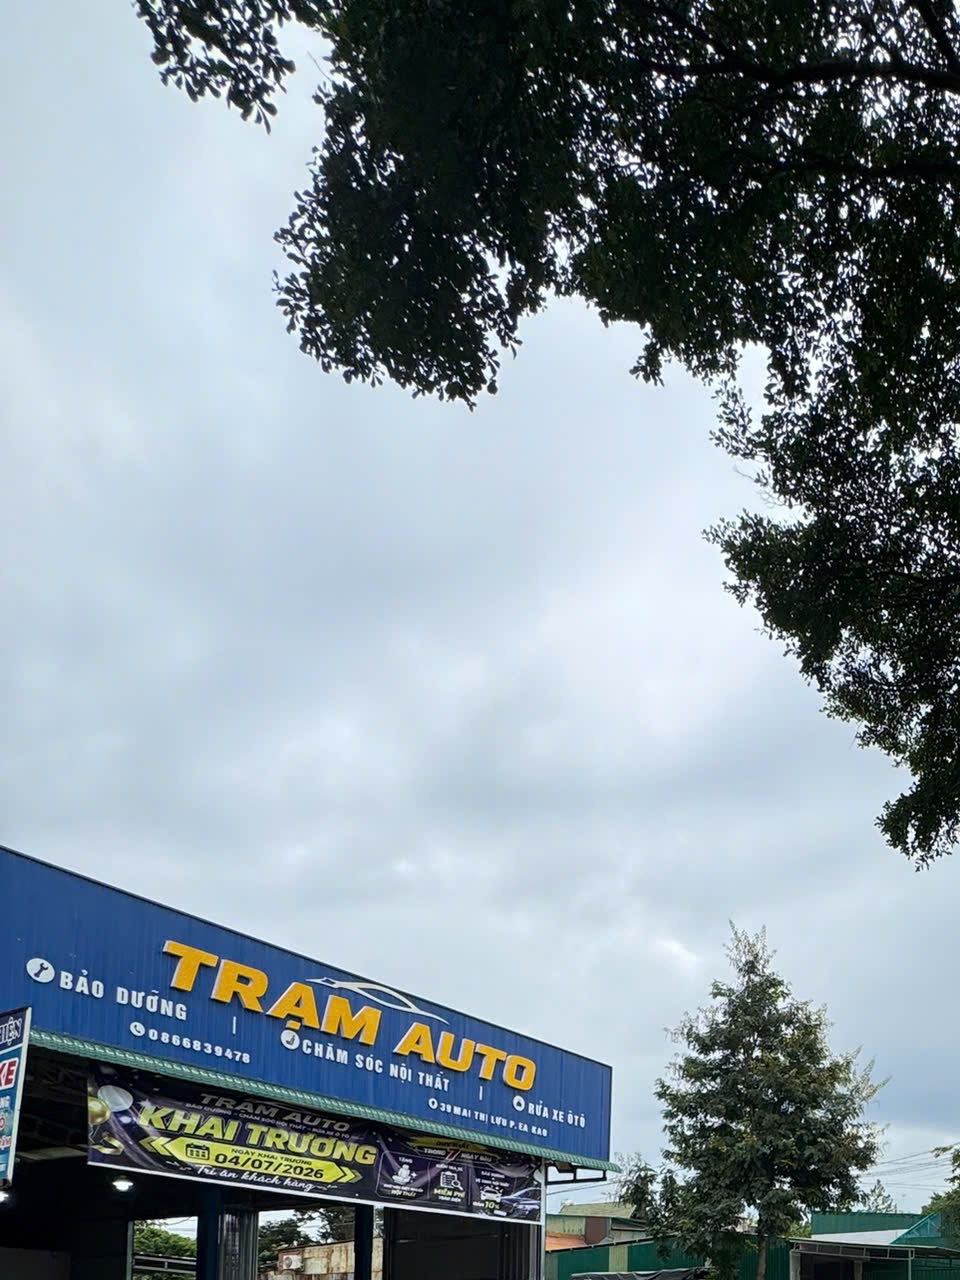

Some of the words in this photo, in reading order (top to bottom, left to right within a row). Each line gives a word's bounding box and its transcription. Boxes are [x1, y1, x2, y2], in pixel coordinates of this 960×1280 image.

[59, 970, 104, 998] BẢO
[116, 986, 187, 1021] DƯỠNG
[162, 939, 382, 1046] TRẠM
[392, 1021, 537, 1092] AUTO
[148, 1028, 250, 1064] 0866839478
[302, 1039, 349, 1066] CHĂM
[355, 1054, 383, 1073] SÓC
[389, 1063, 412, 1084] NỘI
[418, 1070, 449, 1092] THẤT
[199, 1093, 279, 1118] TRẠM
[283, 1112, 350, 1132] AUTO
[439, 1102, 452, 1114] 39
[453, 1106, 471, 1118] MAI
[474, 1111, 489, 1125] THỊ
[531, 1126, 548, 1137] KAO
[528, 1100, 549, 1119] RỬA
[552, 1109, 564, 1123] XE
[567, 1112, 586, 1128] ÔTÔ
[138, 1104, 240, 1142] KHAI
[245, 1123, 377, 1166] TRƯƠNG
[214, 1153, 324, 1179] 04/07/2026
[231, 1148, 255, 1157] NGÀY
[257, 1152, 278, 1161] KHAI
[280, 1156, 312, 1166] TRƯƠNG
[445, 1146, 462, 1162] 7
[241, 1170, 282, 1185] khách
[283, 1176, 315, 1192] hàng
